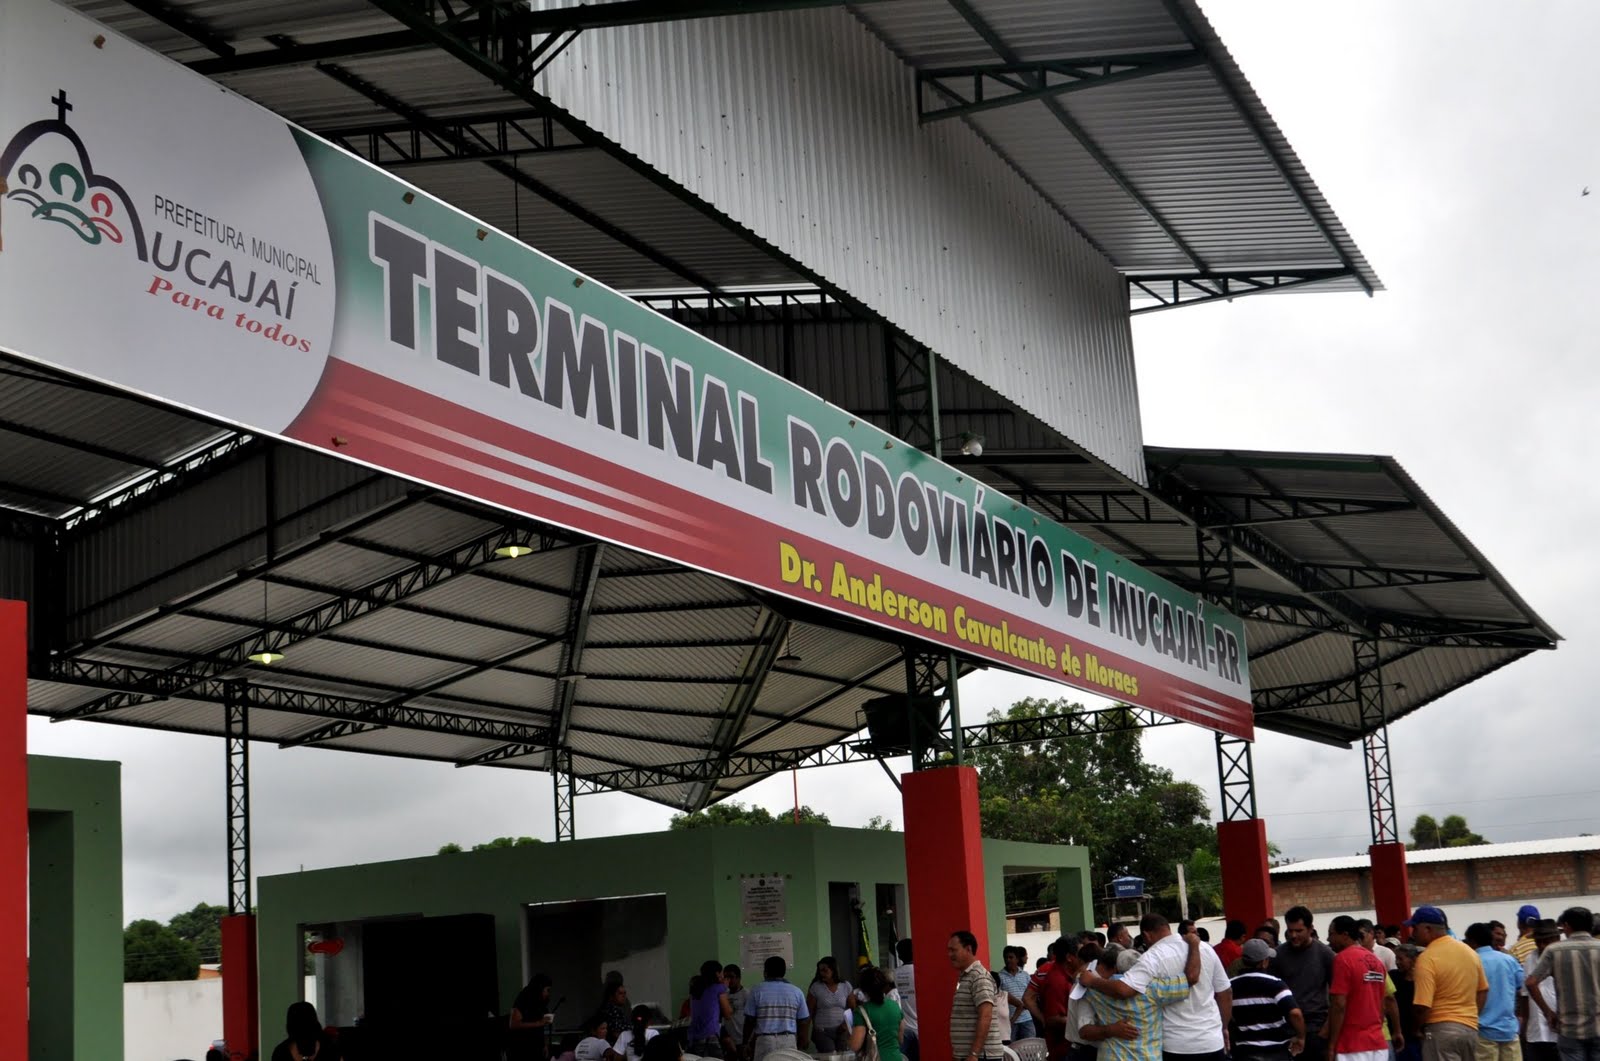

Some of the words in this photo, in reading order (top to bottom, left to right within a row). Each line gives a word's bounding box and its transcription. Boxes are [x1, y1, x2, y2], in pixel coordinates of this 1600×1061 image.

[154, 194, 246, 252] PREFEITURA
[252, 237, 322, 286] MUNICIPAL
[145, 274, 225, 321] Para
[234, 311, 312, 353] todos
[370, 213, 775, 496] TERMINAL
[787, 415, 1055, 609] RODOVIÁRIO
[1061, 548, 1099, 628] DE
[1106, 571, 1243, 686] MUCAJAÍ-RR
[779, 541, 823, 594] Dr.
[830, 561, 948, 634] Anderson
[953, 605, 1057, 670] Cavalcante
[1061, 643, 1081, 677] de
[1085, 653, 1139, 697] Moraes
